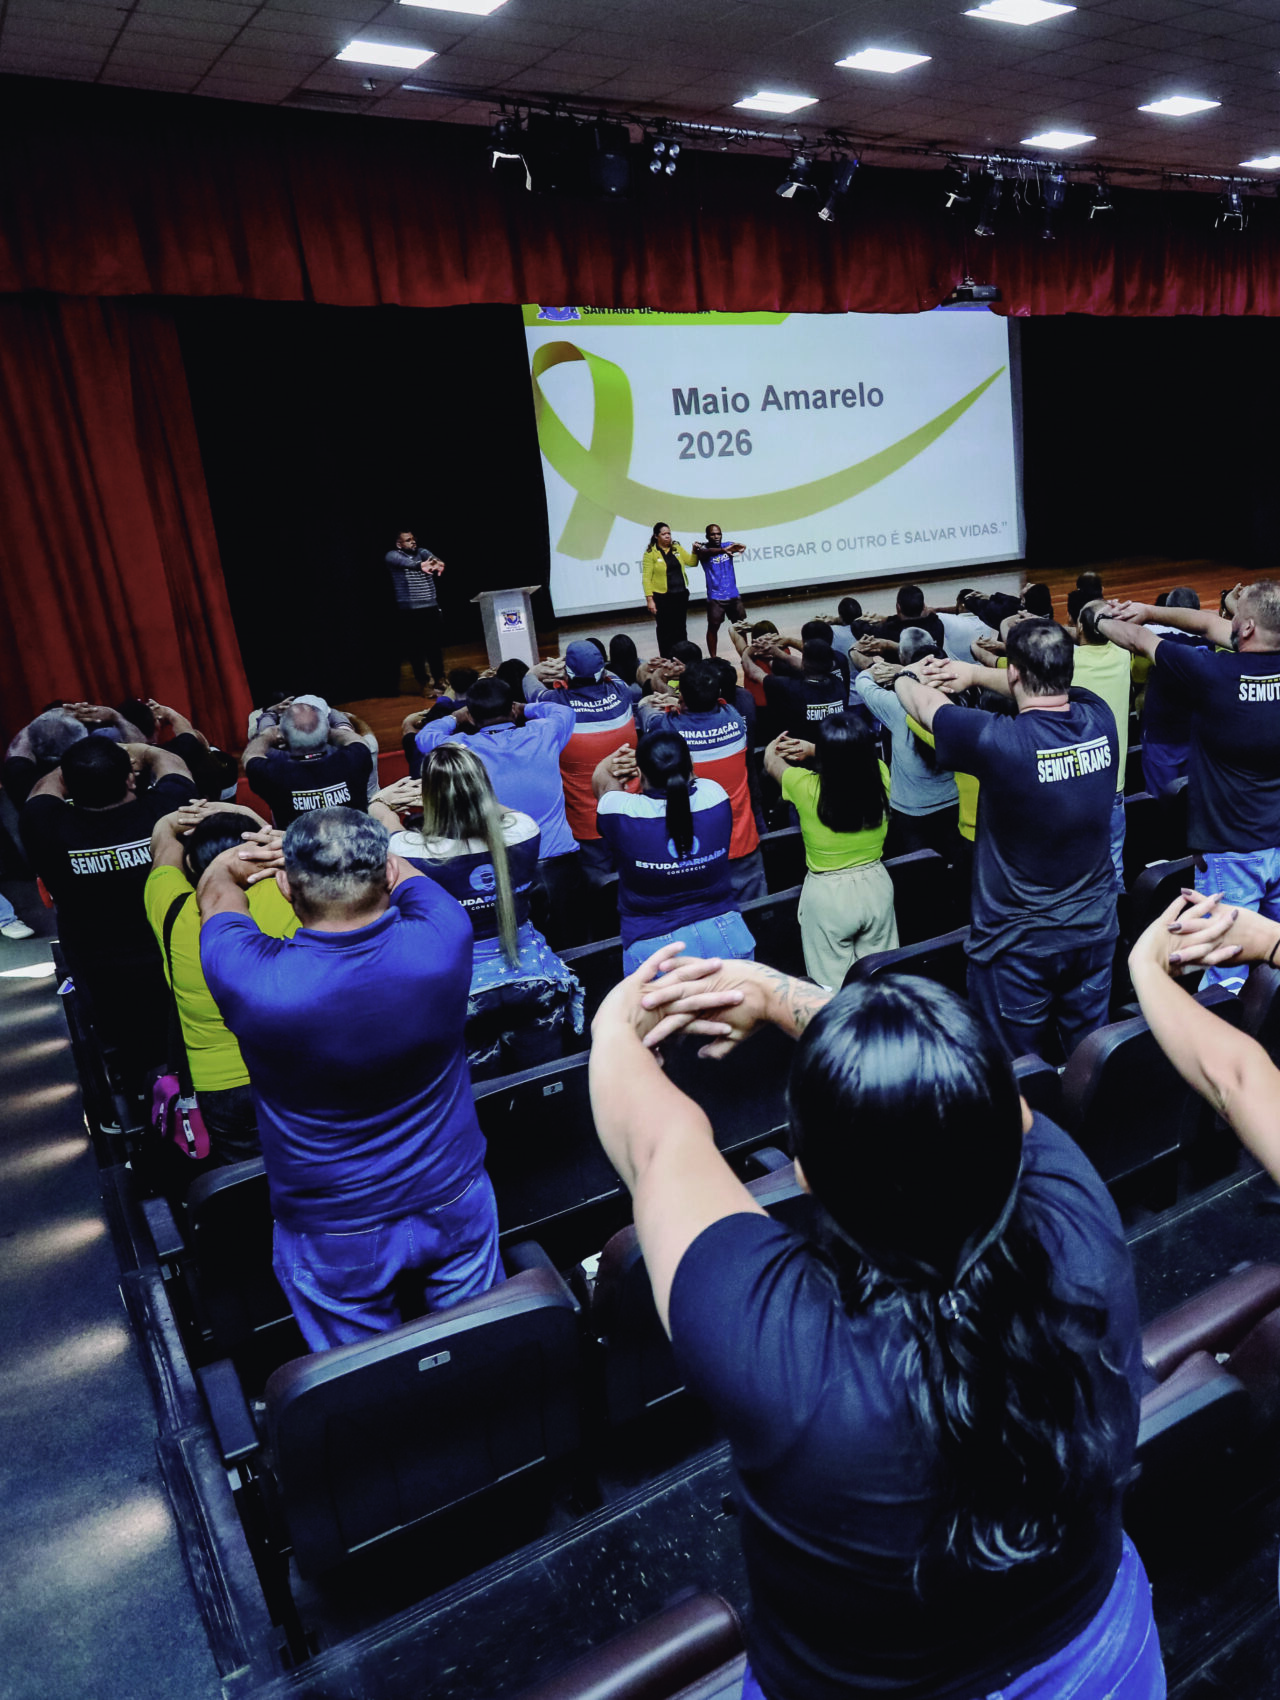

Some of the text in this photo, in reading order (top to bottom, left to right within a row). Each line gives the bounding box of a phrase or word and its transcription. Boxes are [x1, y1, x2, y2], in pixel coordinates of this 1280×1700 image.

[671, 381, 885, 416] Maio Amarelo
[676, 428, 753, 460] 2026
[821, 540, 832, 553] O
[836, 534, 887, 551] OUTRO
[890, 530, 900, 545] É
[904, 527, 957, 544] SALVAR
